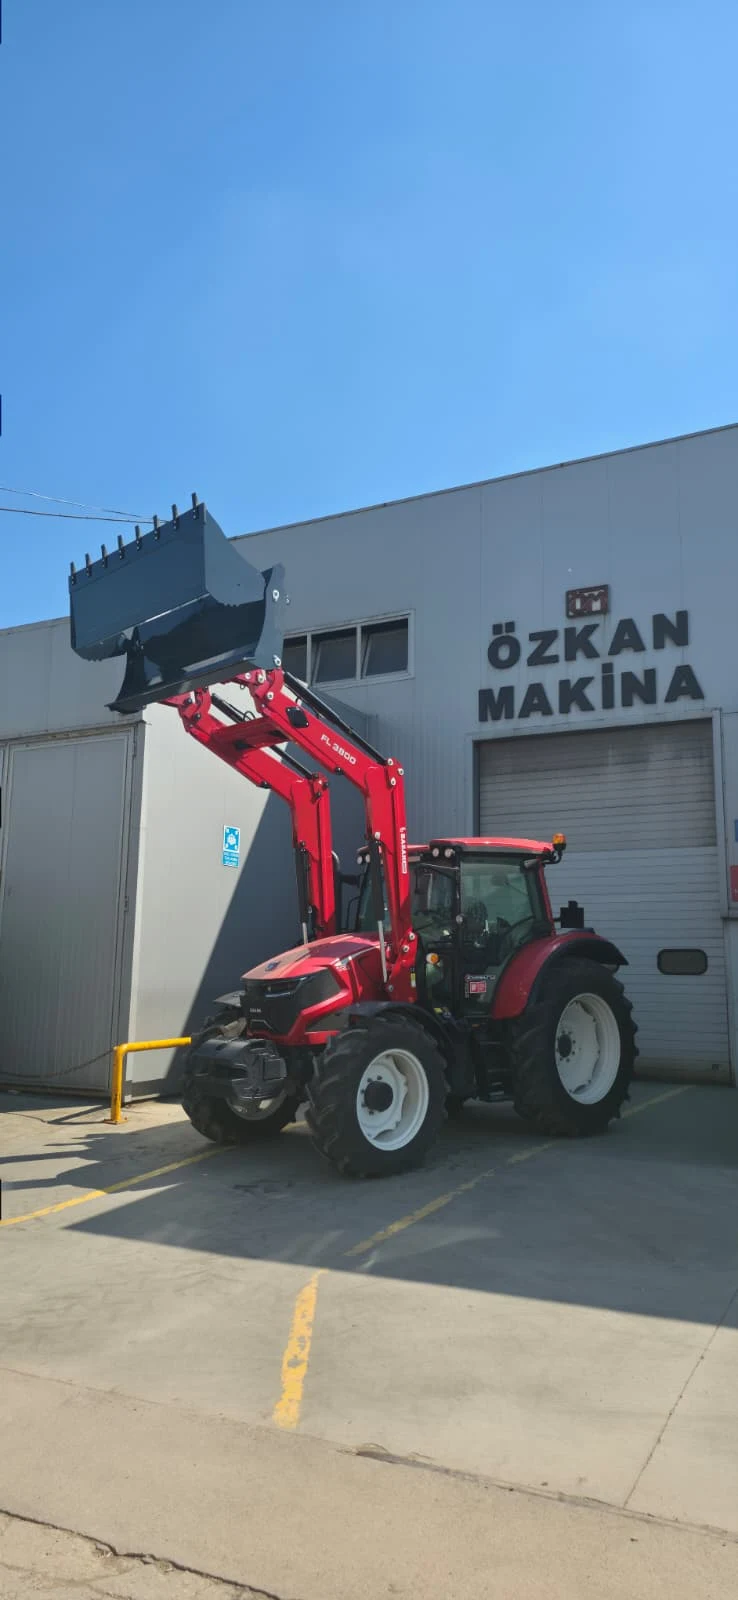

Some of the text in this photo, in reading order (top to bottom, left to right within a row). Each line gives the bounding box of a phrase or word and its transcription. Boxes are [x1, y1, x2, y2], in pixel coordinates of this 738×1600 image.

[487, 610, 689, 669] ÖZKAN
[478, 662, 705, 722] MAKİNA
[320, 734, 357, 765] FL 3800
